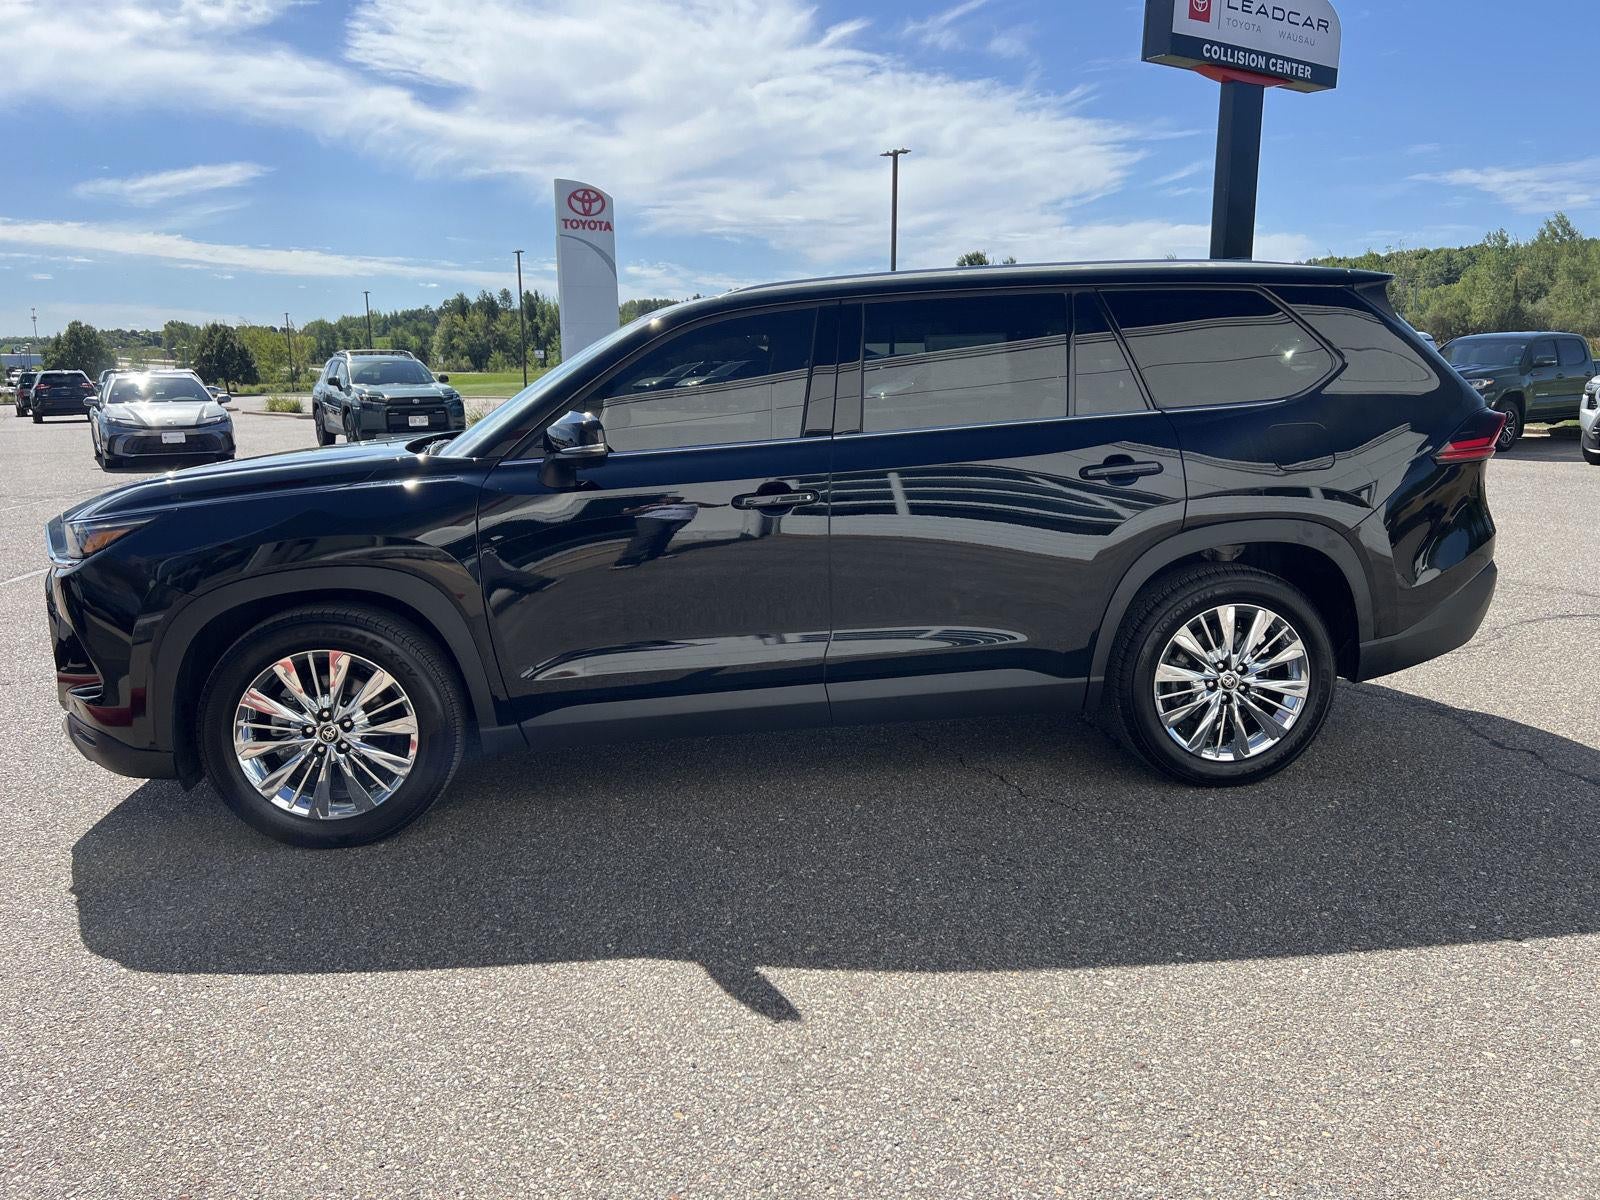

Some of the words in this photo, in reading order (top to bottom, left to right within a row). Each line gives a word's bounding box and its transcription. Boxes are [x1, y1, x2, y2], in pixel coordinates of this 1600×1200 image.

[1225, 17, 1262, 33] TOYOTA
[1278, 30, 1316, 47] WAUSAU
[1227, 0, 1330, 33] LEADCAR
[1202, 43, 1266, 69] COLLISION
[1268, 58, 1312, 80] CENTER
[561, 218, 613, 232] TOYOTA
